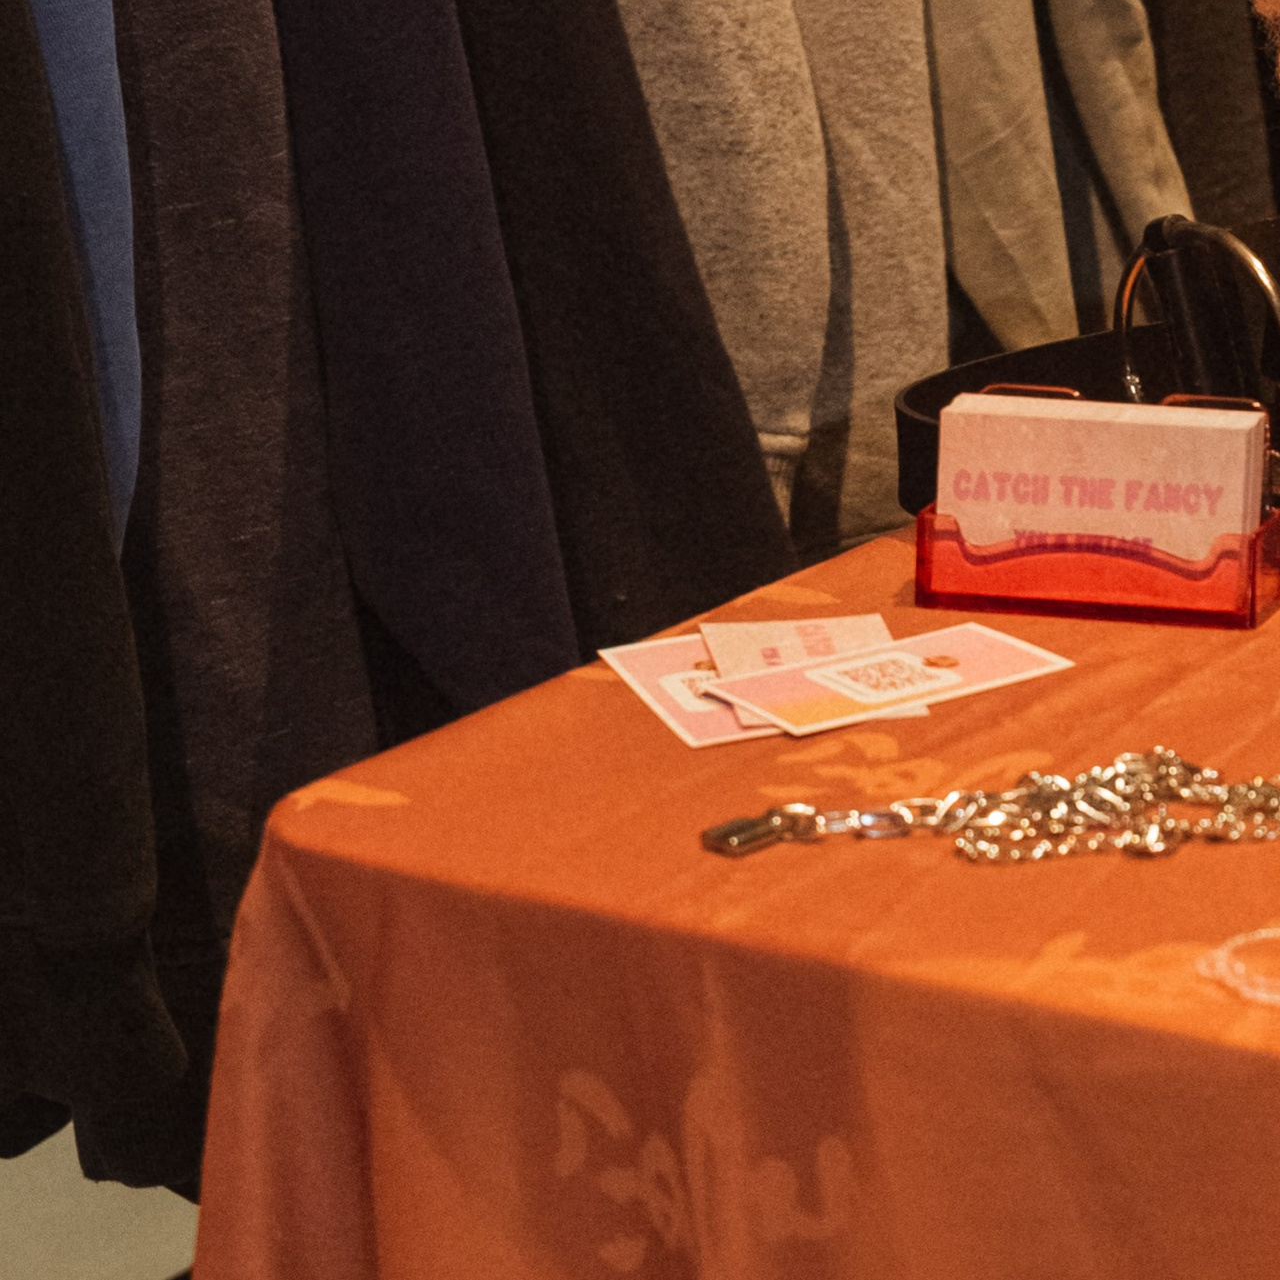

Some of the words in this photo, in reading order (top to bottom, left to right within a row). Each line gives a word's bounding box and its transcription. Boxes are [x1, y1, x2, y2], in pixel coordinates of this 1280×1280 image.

[953, 468, 1050, 506] CATCH
[1059, 475, 1117, 510] THE
[1124, 479, 1225, 517] FANCY
